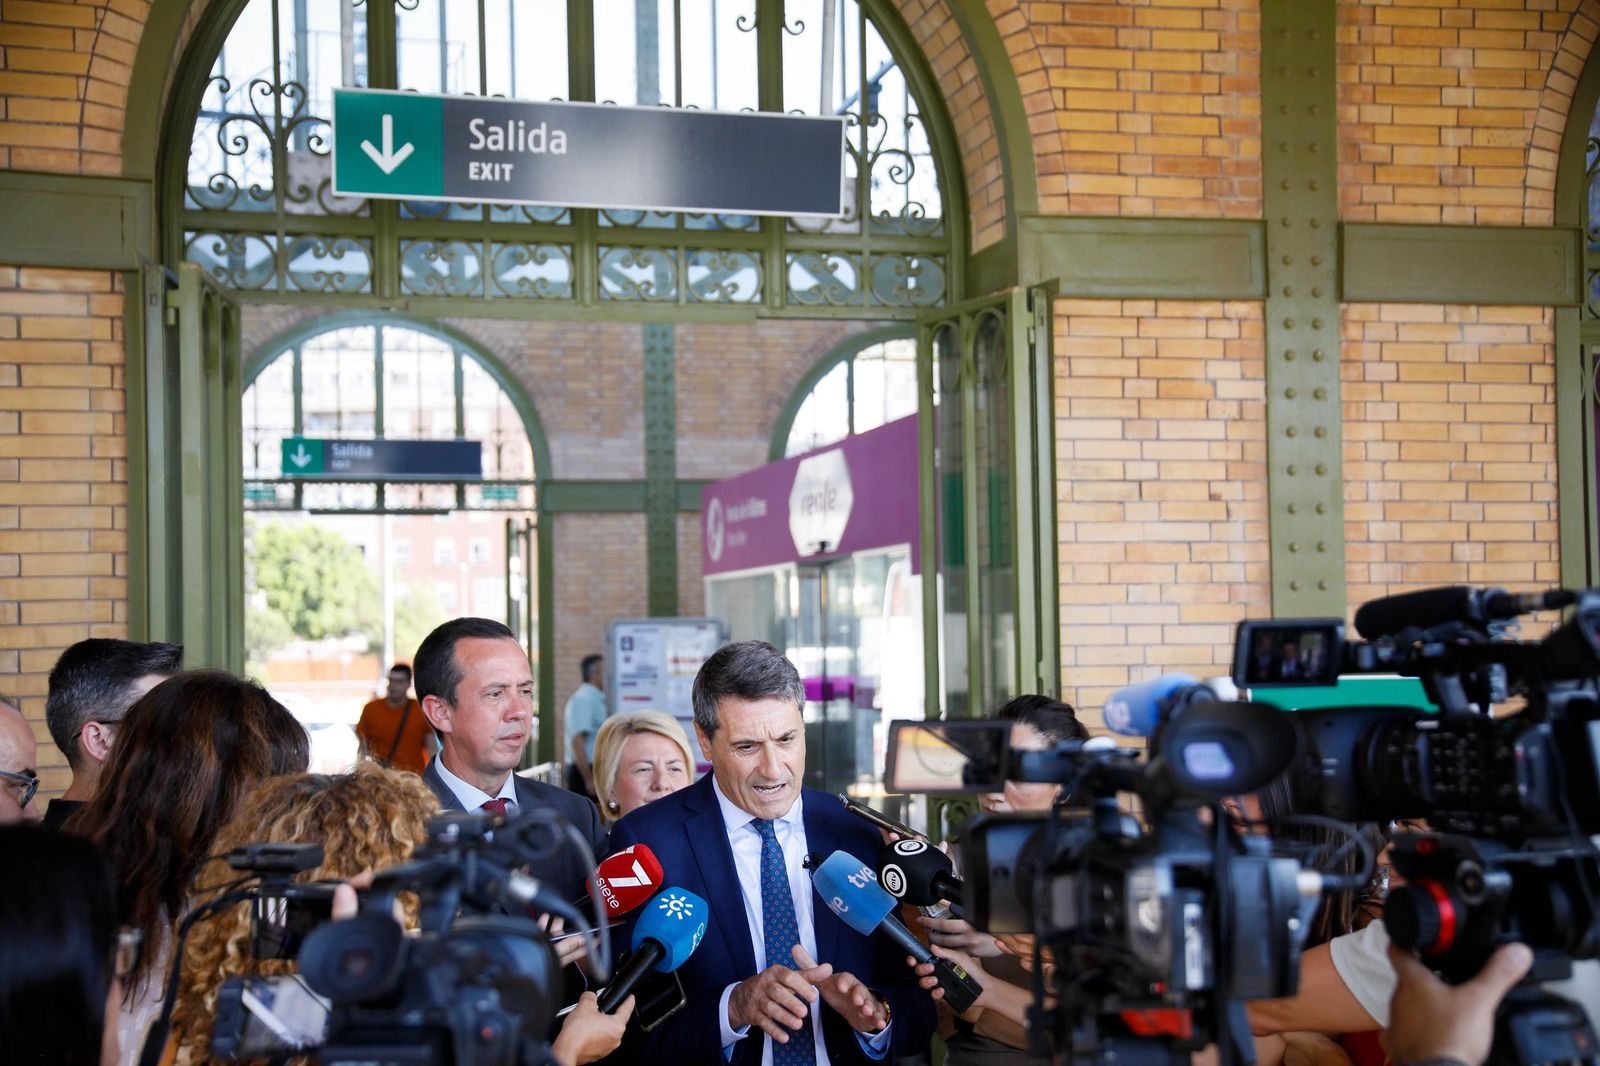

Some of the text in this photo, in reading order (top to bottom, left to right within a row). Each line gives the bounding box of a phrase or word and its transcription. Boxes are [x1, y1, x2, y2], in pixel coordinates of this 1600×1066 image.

[469, 118, 568, 155] Salida
[468, 161, 514, 182] EXIT
[331, 442, 374, 459] Salida
[847, 866, 878, 889] tve
[596, 877, 620, 909] siete
